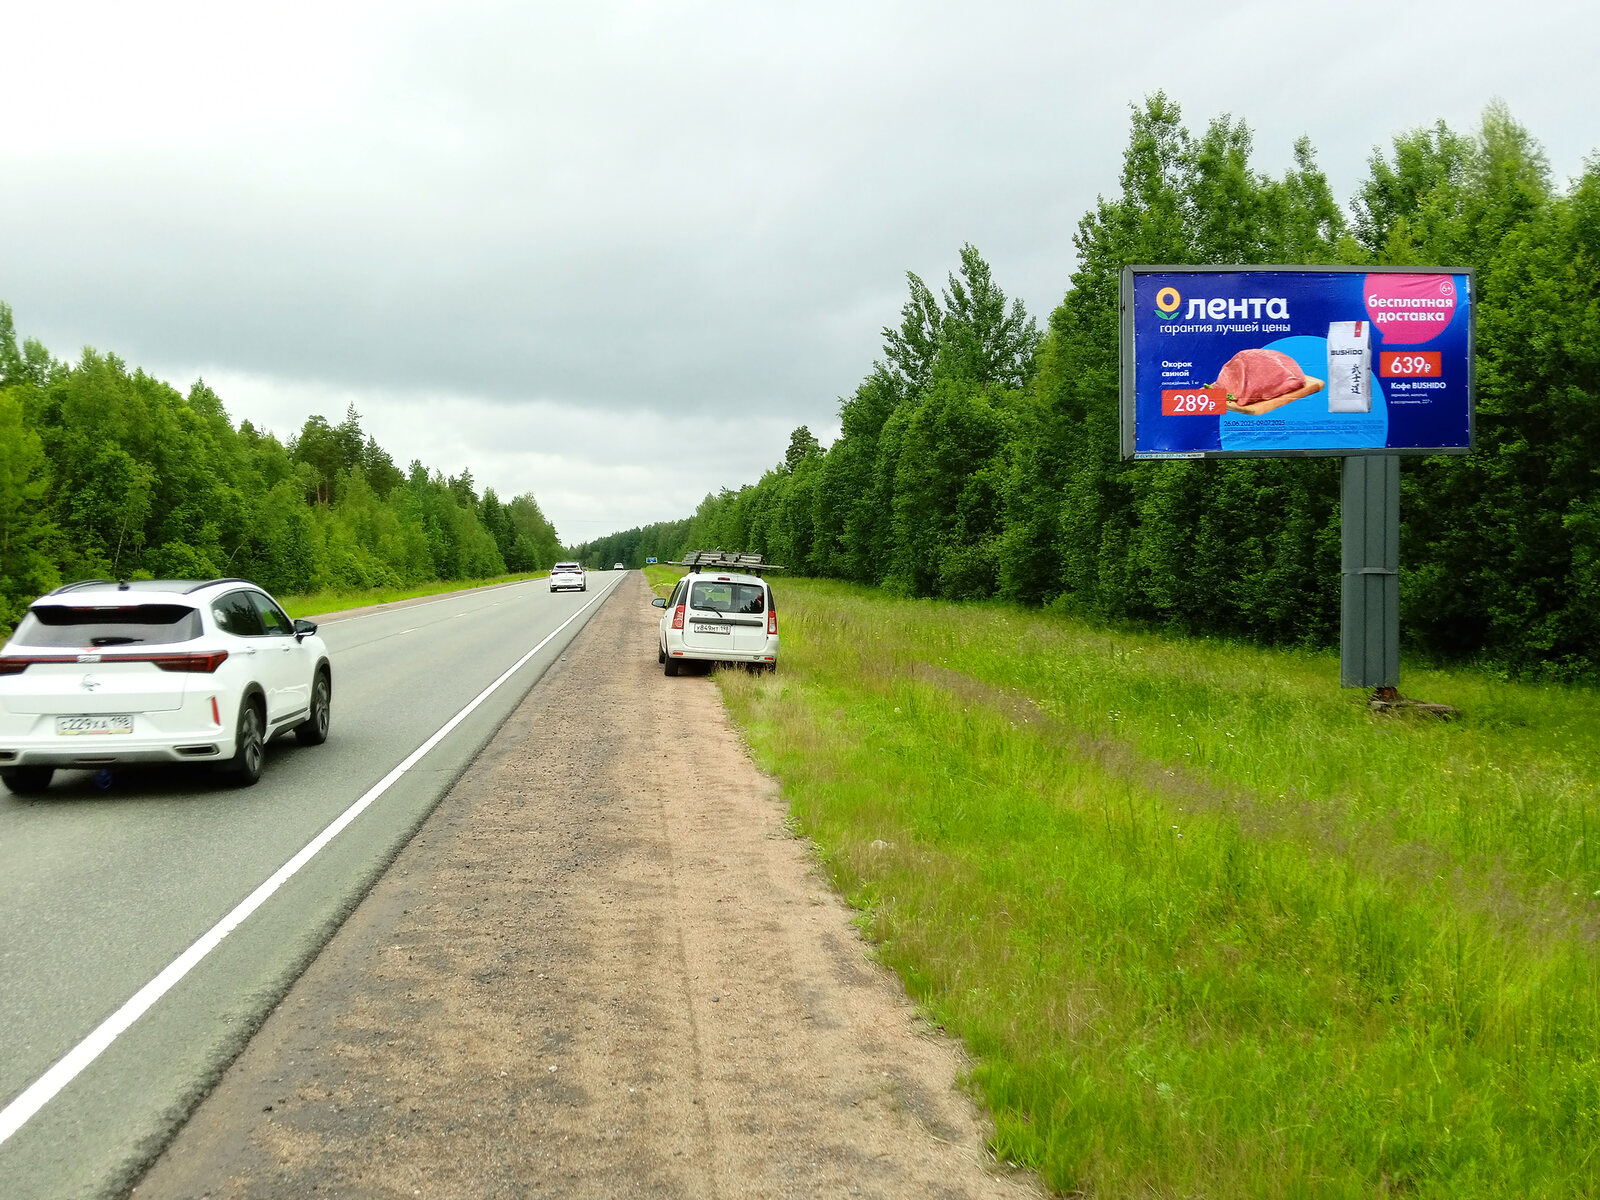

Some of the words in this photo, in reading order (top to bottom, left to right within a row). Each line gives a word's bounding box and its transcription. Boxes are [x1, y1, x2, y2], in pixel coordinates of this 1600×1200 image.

[1368, 294, 1453, 308] бесплатная
[1185, 297, 1290, 320] лента
[1376, 312, 1445, 323] доставка
[1160, 324, 1213, 336] гарантия
[1215, 321, 1259, 335] лучшей
[1262, 324, 1291, 333] цены
[1161, 360, 1193, 369] Окорок
[1391, 382, 1411, 391] Кофе
